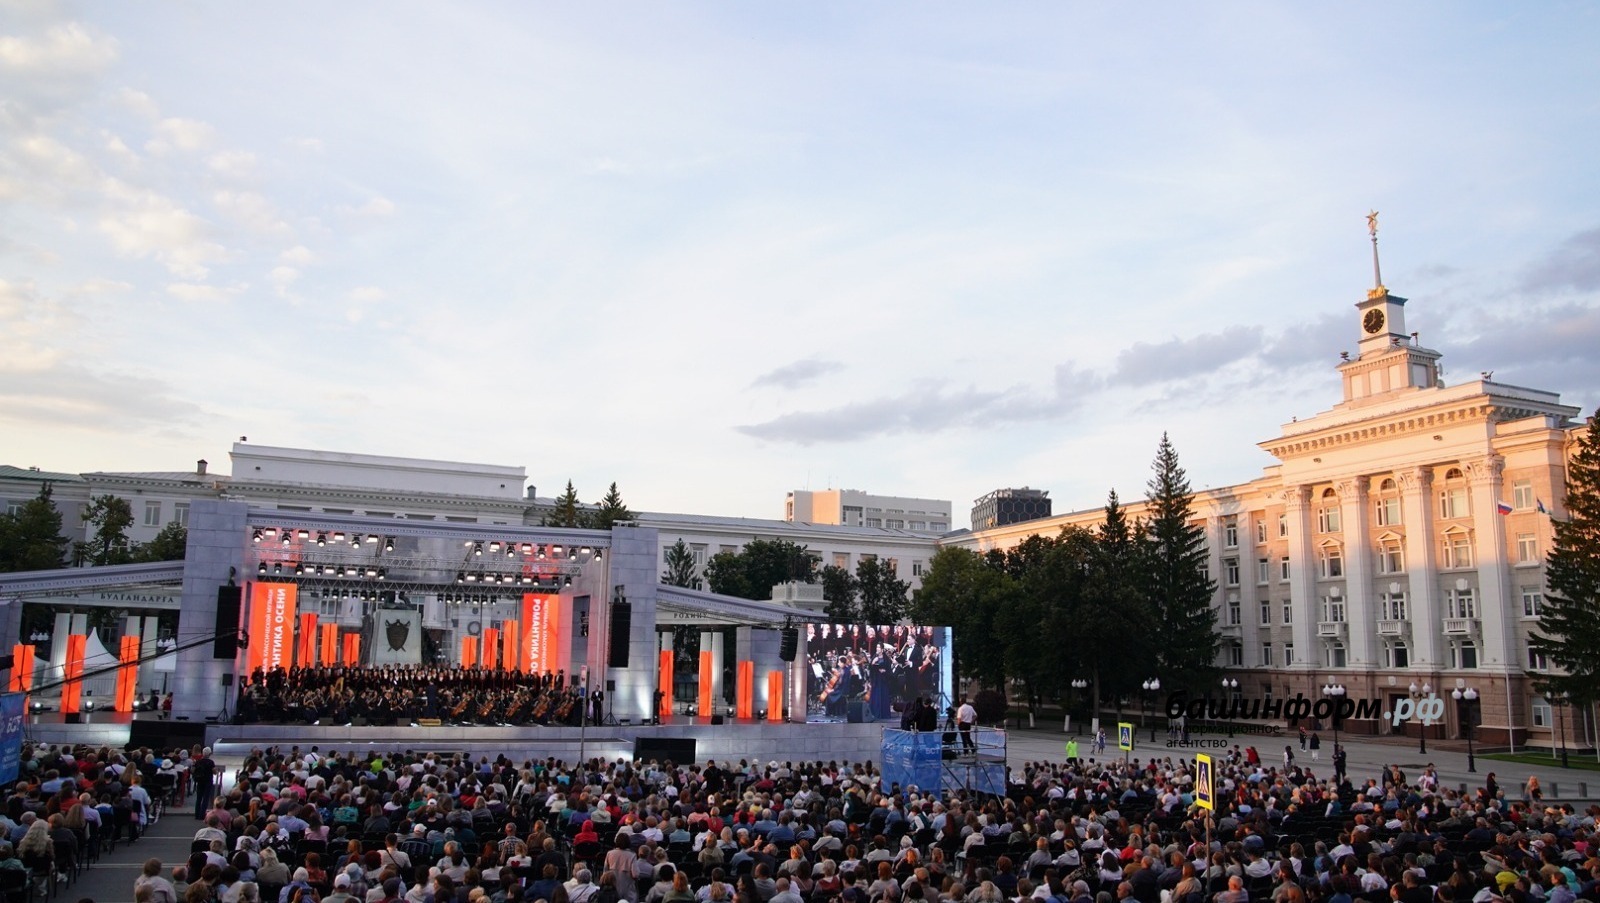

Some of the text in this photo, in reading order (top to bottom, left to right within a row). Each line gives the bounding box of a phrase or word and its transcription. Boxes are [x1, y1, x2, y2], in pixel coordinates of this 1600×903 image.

[272, 588, 286, 671] АНТИКА ОСЕНИ
[530, 598, 541, 660] РОМАНТИКА
